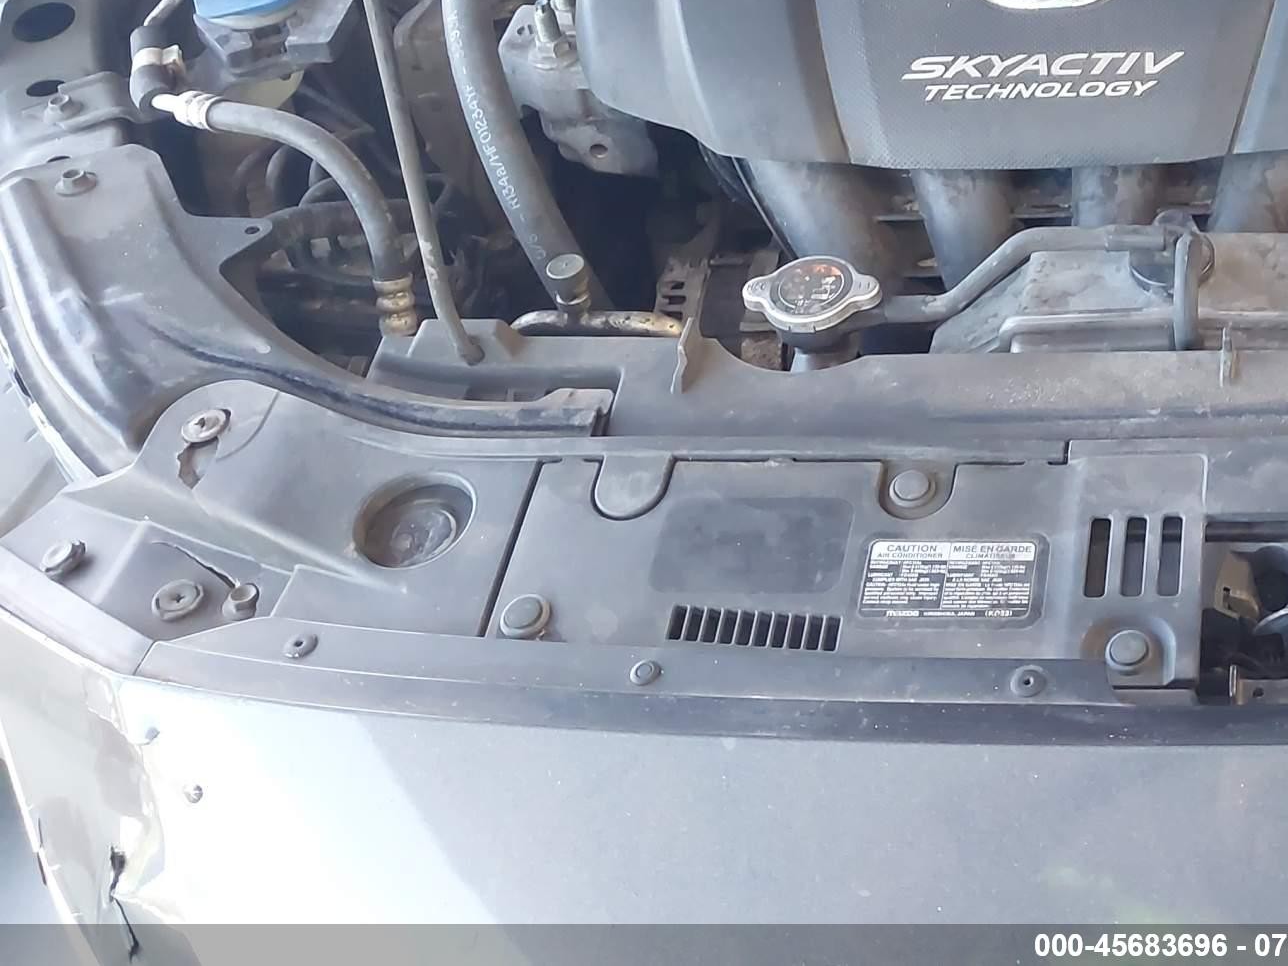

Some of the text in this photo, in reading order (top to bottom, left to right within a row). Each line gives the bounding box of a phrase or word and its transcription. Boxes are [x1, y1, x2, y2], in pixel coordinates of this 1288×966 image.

[901, 51, 1184, 80] SKYACTIV
[925, 80, 1158, 101] TECHNOLOGY
[887, 544, 938, 552] CAUTION
[980, 545, 994, 553] EN
